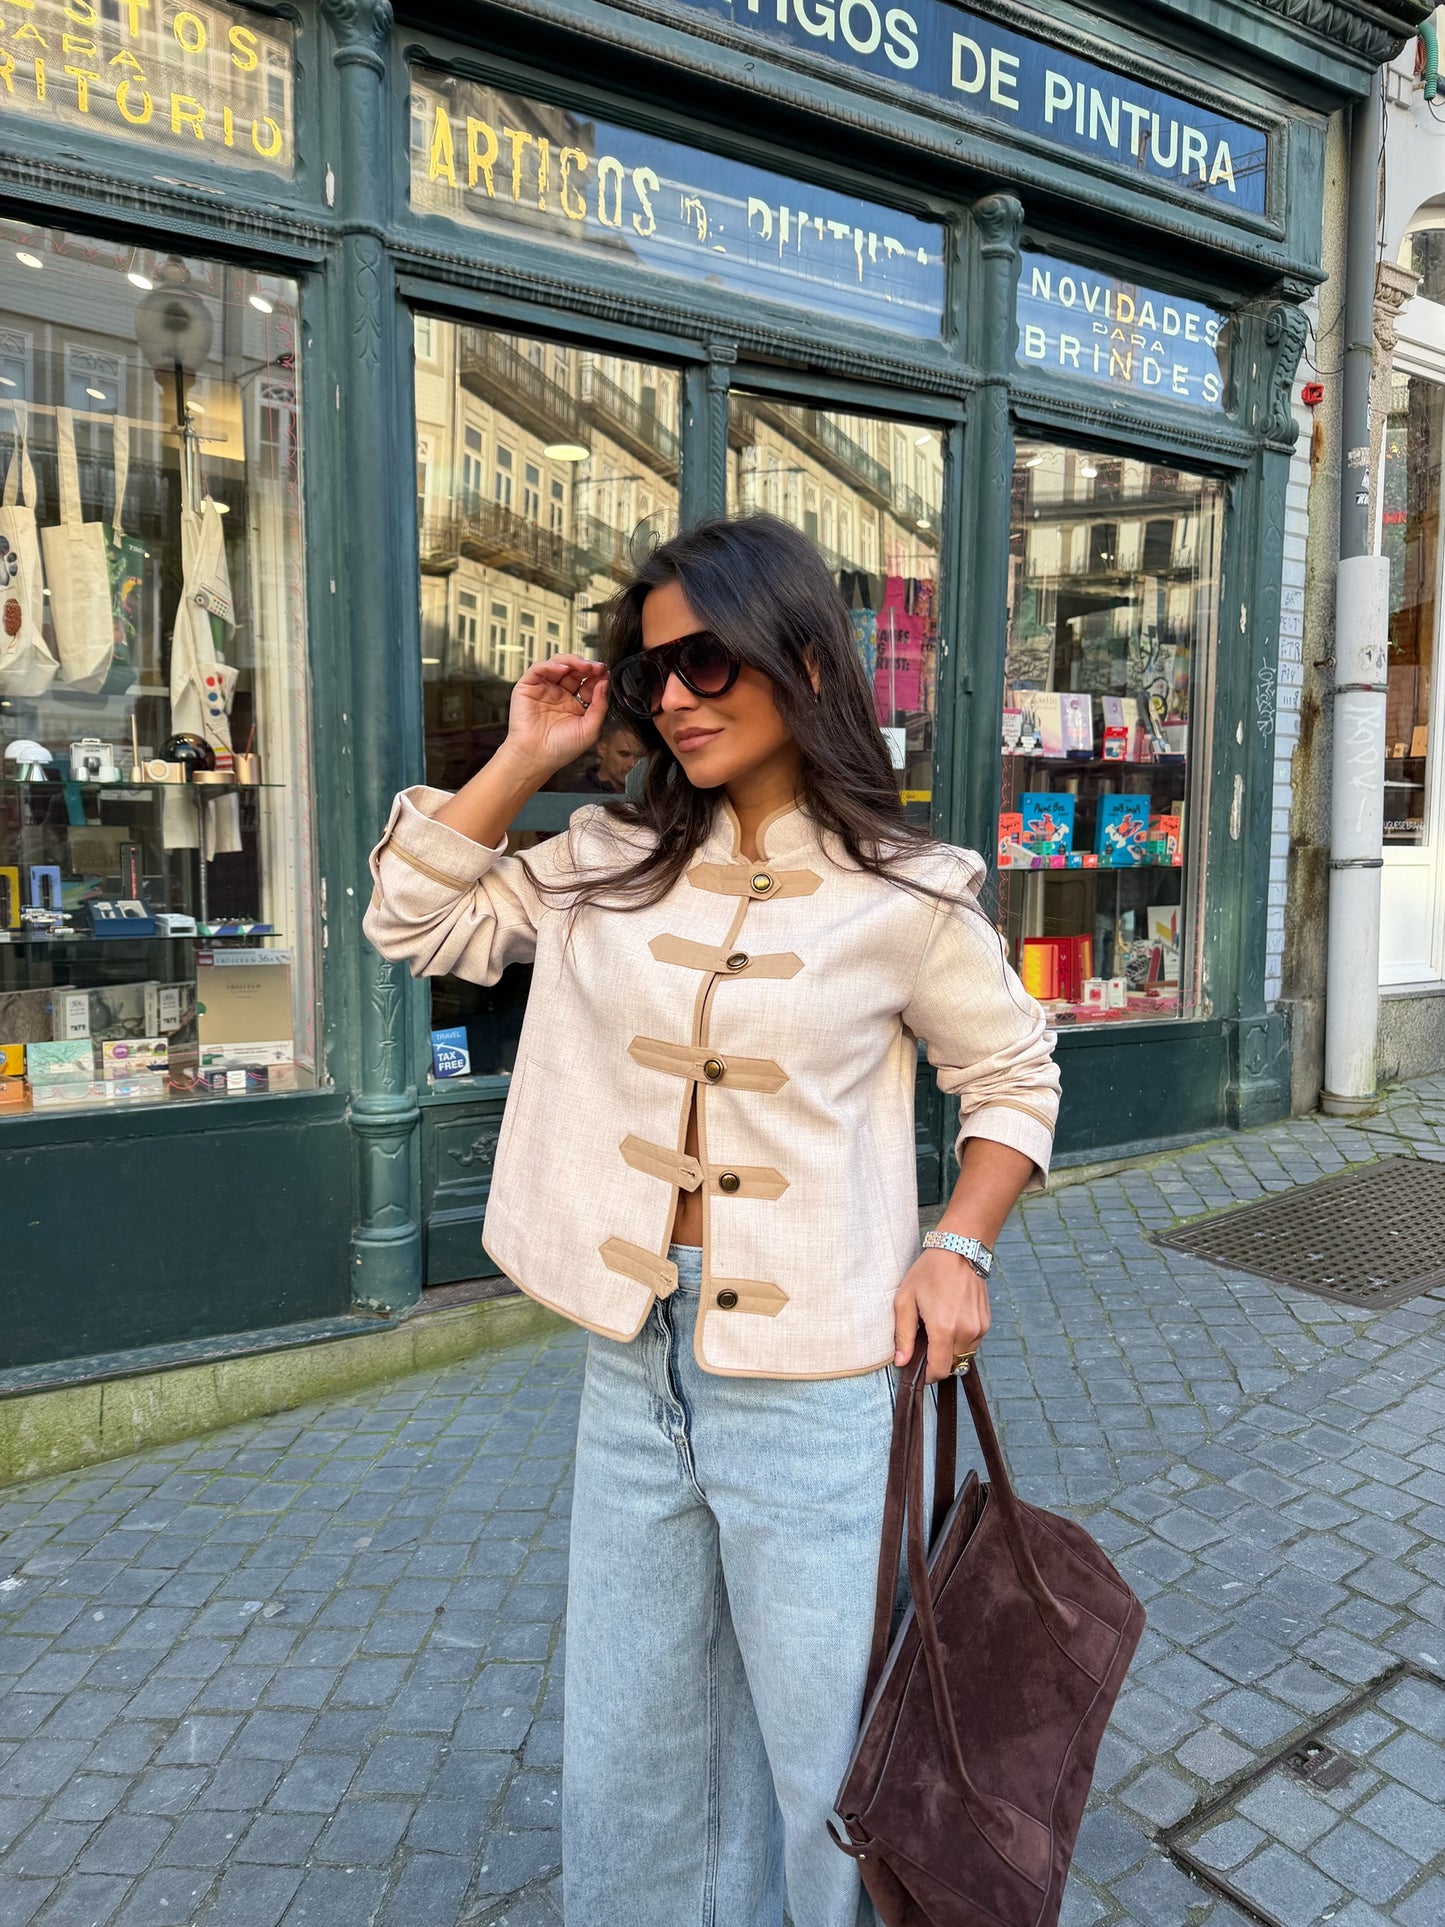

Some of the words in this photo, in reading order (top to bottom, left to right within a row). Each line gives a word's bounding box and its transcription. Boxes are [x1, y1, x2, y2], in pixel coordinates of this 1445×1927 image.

[0, 17, 144, 73] ARA
[6, 0, 258, 71] STOS
[951, 32, 1019, 111] DE
[1044, 70, 1237, 193] PINTURA
[429, 106, 660, 237] ARTIGOS
[1031, 267, 1220, 348] NOVIDADES
[1092, 321, 1166, 355] PARA
[1024, 324, 1220, 403] BRINDES
[436, 1031, 461, 1040] TRAVEL
[438, 1051, 456, 1061] TAX
[439, 1059, 464, 1071] FREE
